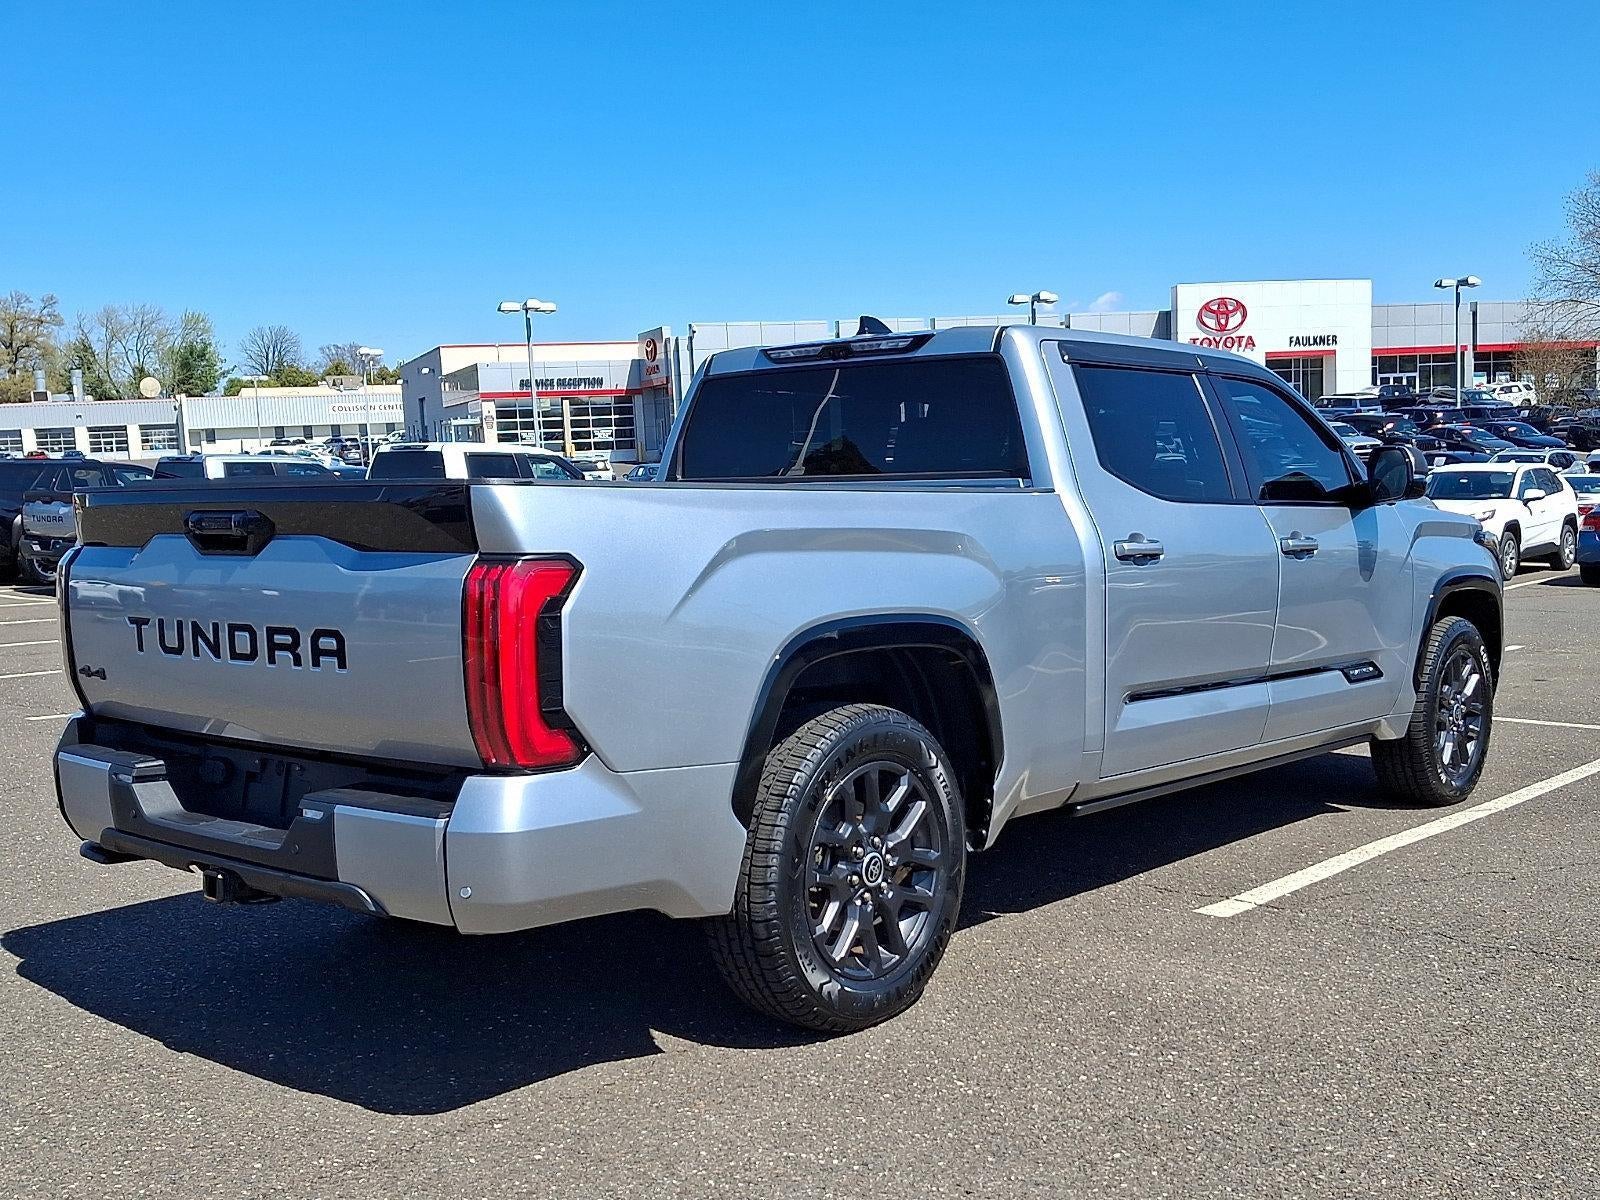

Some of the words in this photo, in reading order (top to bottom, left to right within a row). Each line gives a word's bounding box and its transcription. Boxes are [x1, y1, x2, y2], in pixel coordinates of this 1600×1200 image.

[1189, 335, 1256, 350] TOYOTA
[1289, 334, 1338, 347] FAULKNER
[519, 378, 555, 390] SEVICE
[556, 377, 604, 390] RECEPTION
[31, 514, 64, 523] TUNDRA
[125, 616, 348, 672] TUNDRA
